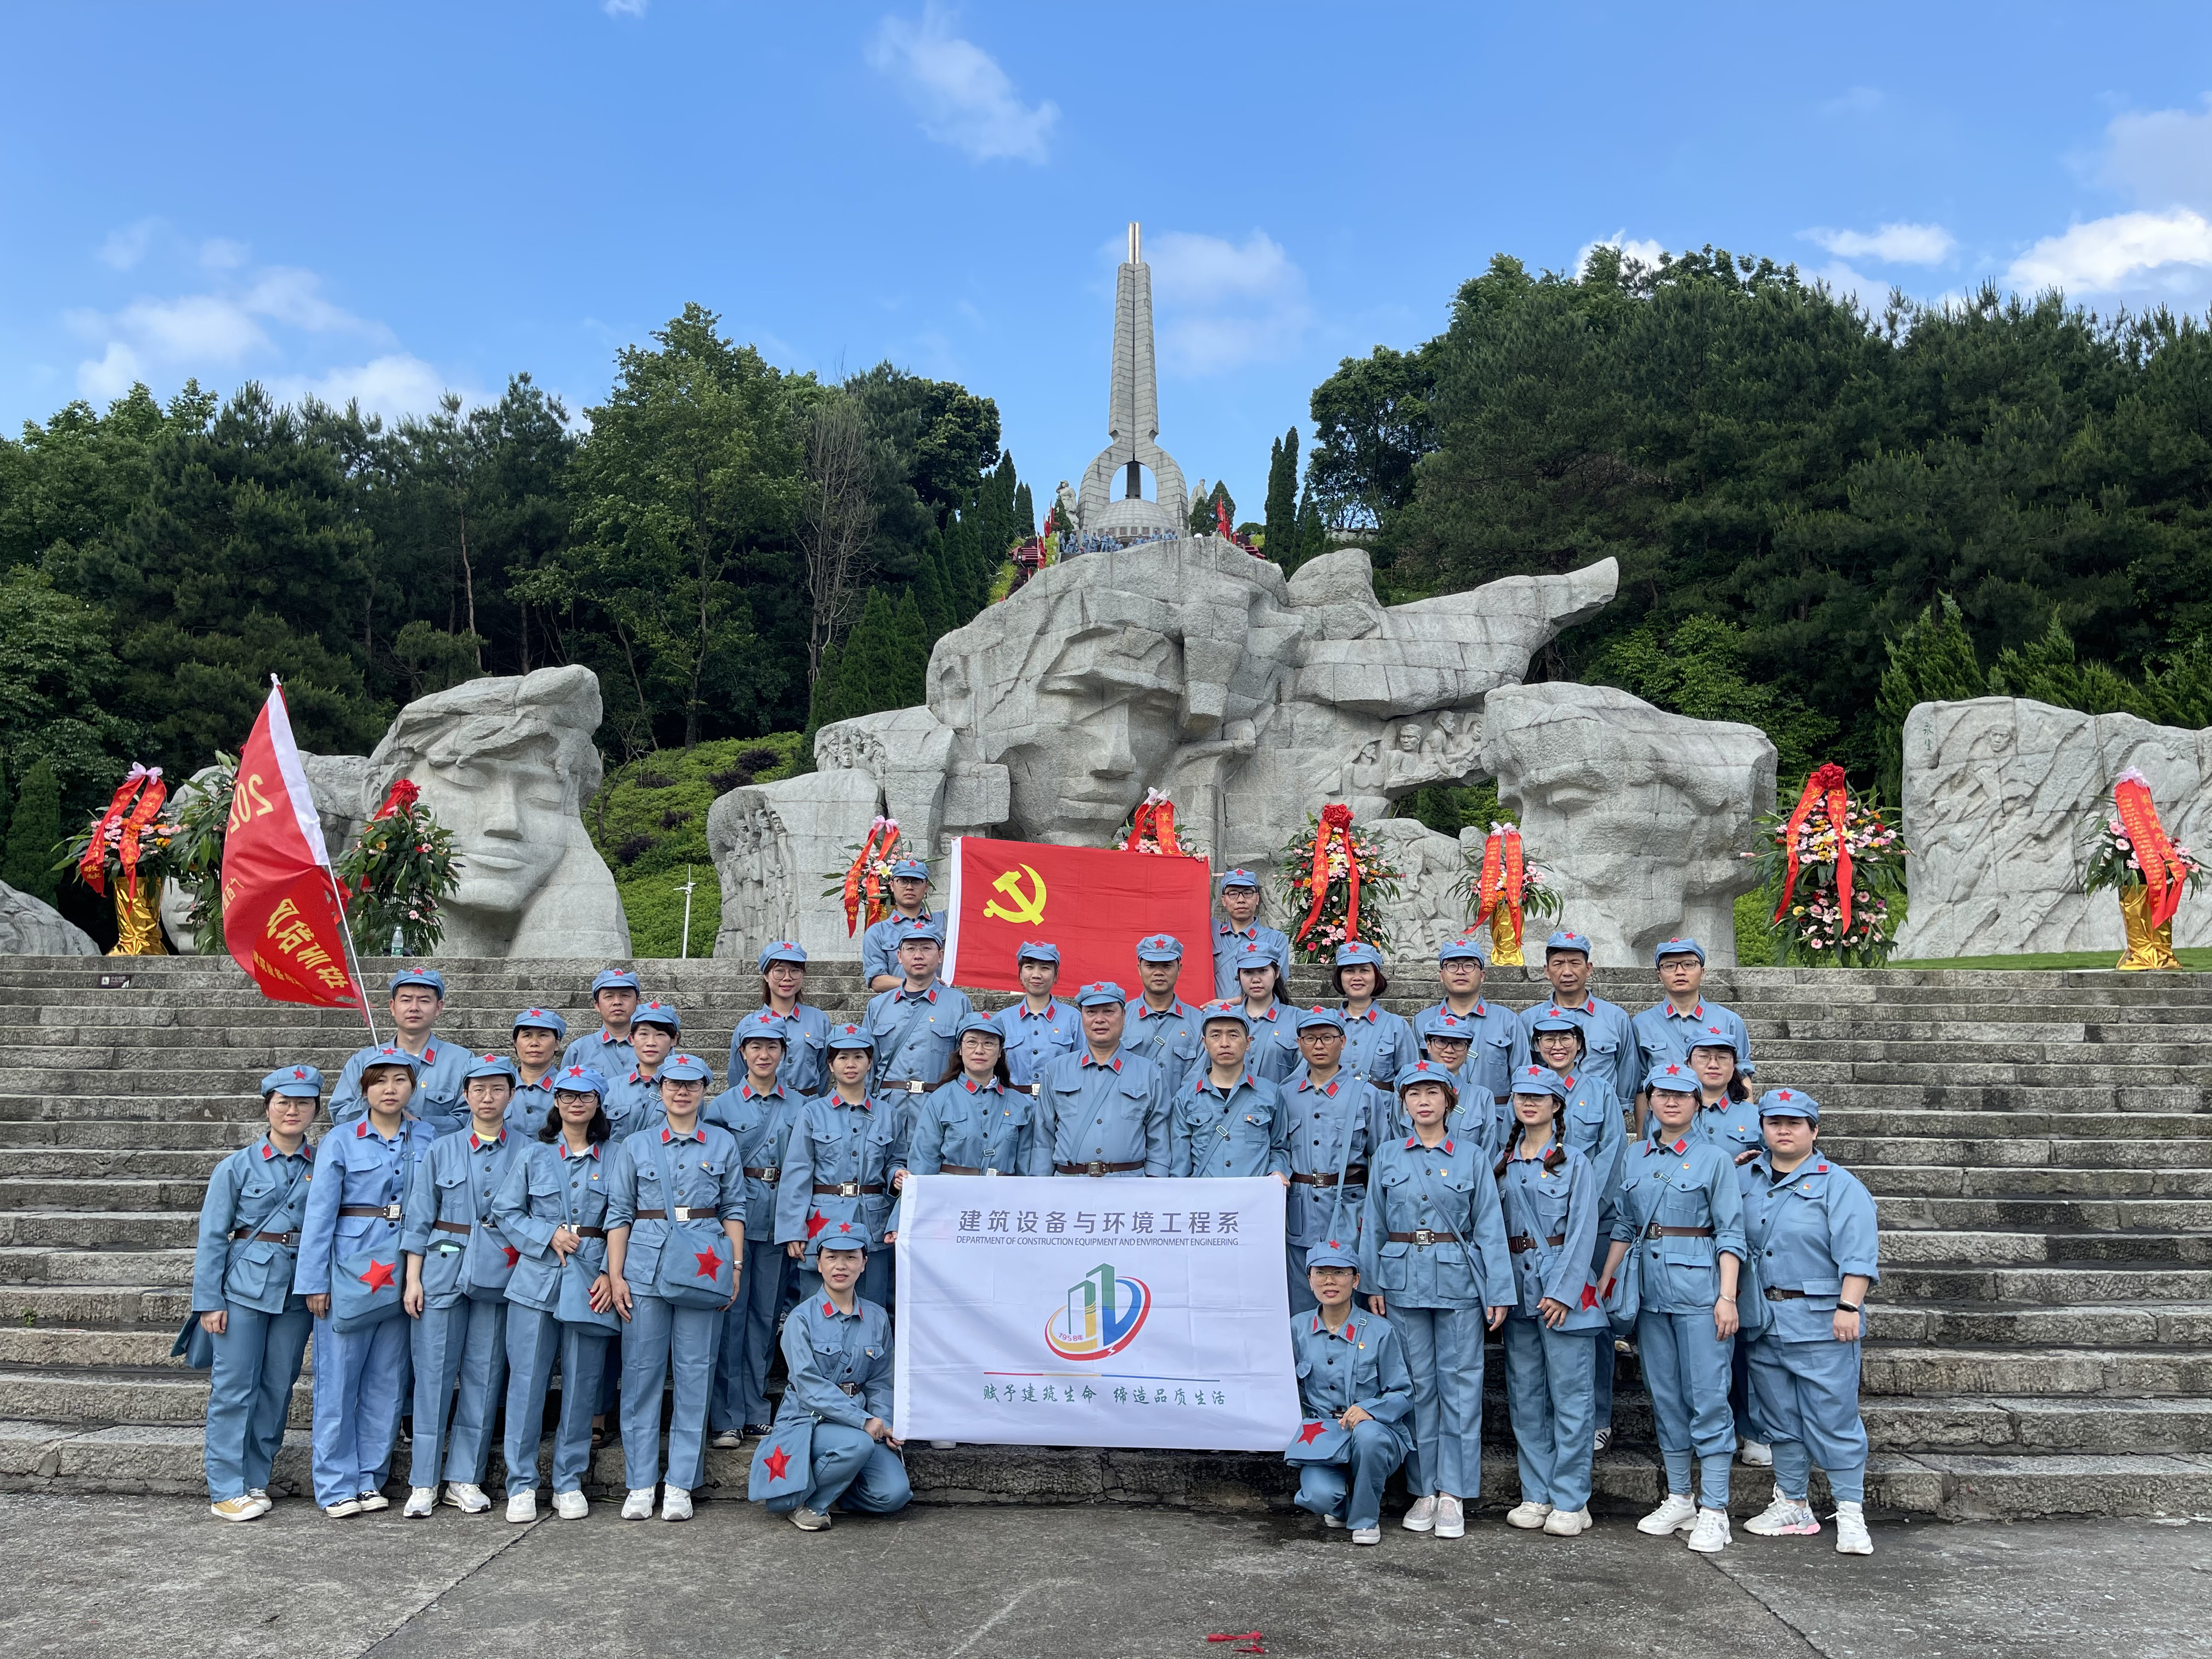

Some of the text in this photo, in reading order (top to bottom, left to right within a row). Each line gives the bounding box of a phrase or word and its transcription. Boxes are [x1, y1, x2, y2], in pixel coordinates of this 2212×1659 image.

[958, 1210, 1239, 1234] 建筑设备与环境工程系
[956, 1235, 1005, 1244] DEPARTMENT
[1017, 1237, 1073, 1245] CONSTRUCTION
[1075, 1238, 1118, 1246] EQUIPMENT
[1137, 1238, 1189, 1246] ENVIRONMENT
[1190, 1238, 1238, 1246] ENGINEERING
[1059, 1333, 1083, 1341] 1958年
[984, 1383, 1225, 1405] 赋予建筑生命 缔造品质生活
